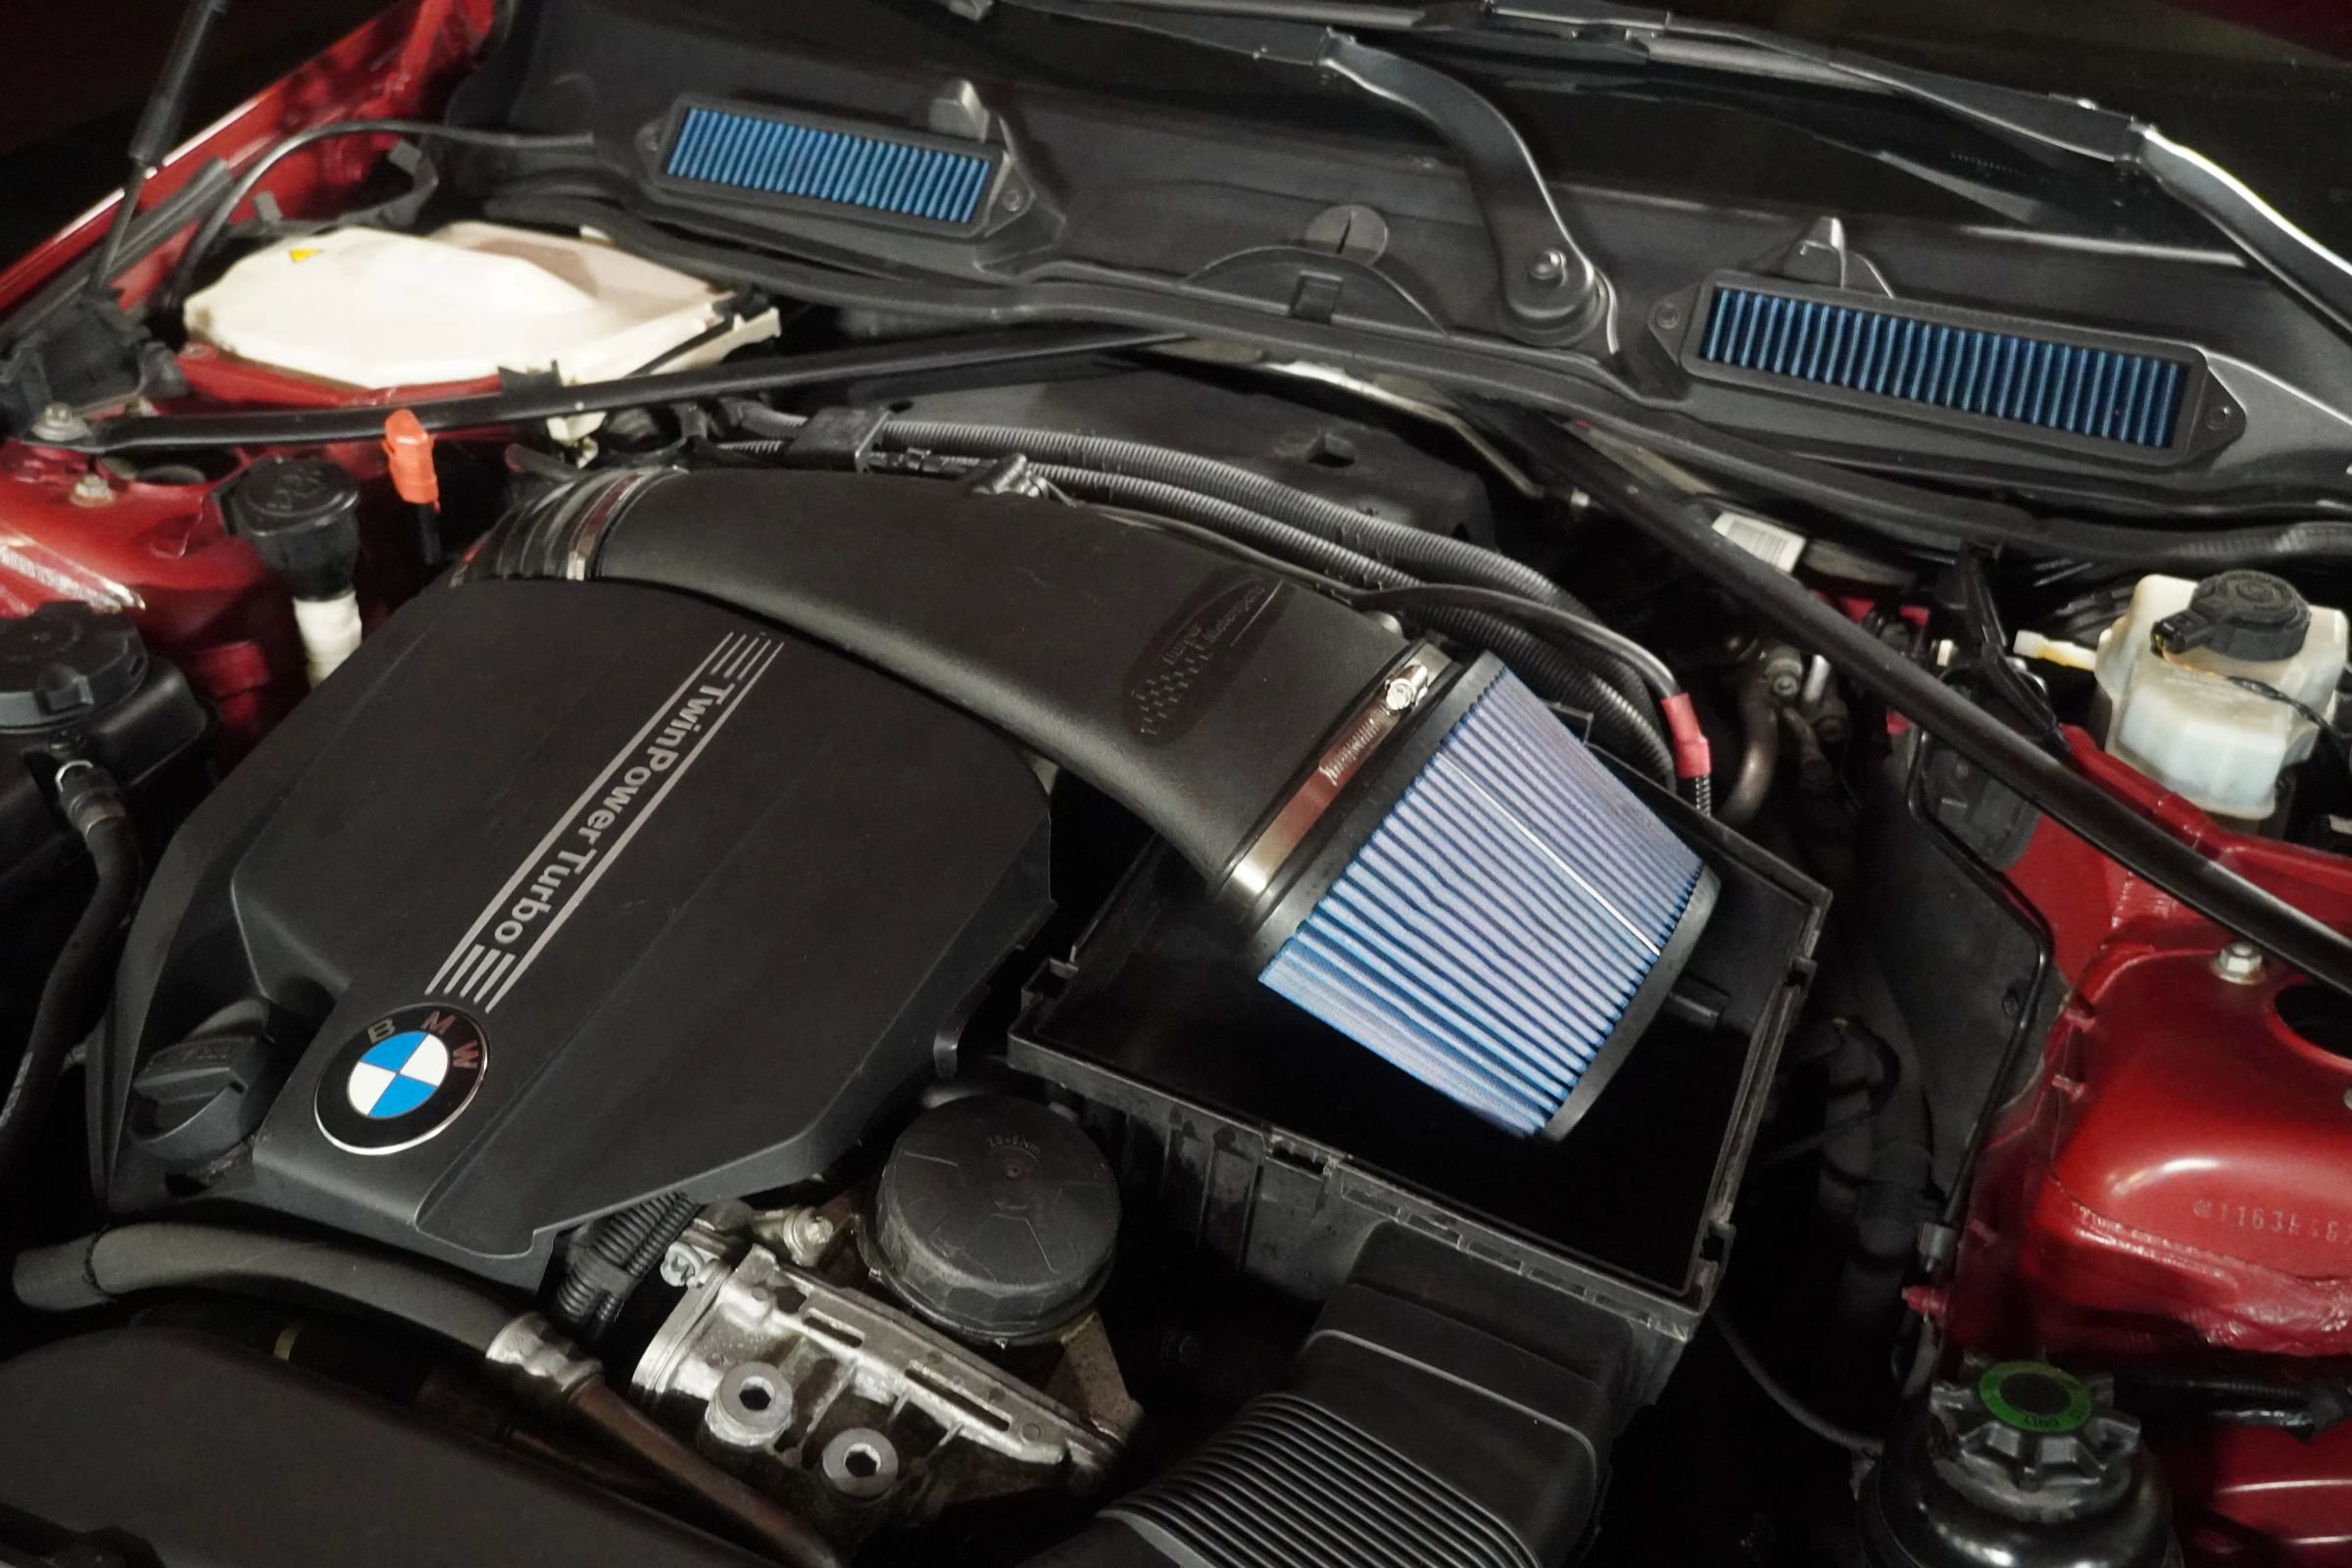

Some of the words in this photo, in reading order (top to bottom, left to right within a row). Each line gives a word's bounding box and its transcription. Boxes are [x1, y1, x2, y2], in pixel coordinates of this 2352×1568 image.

[576, 682, 735, 846] TwinPower
[494, 849, 598, 944] Turbo
[367, 1010, 479, 1069] BMW
